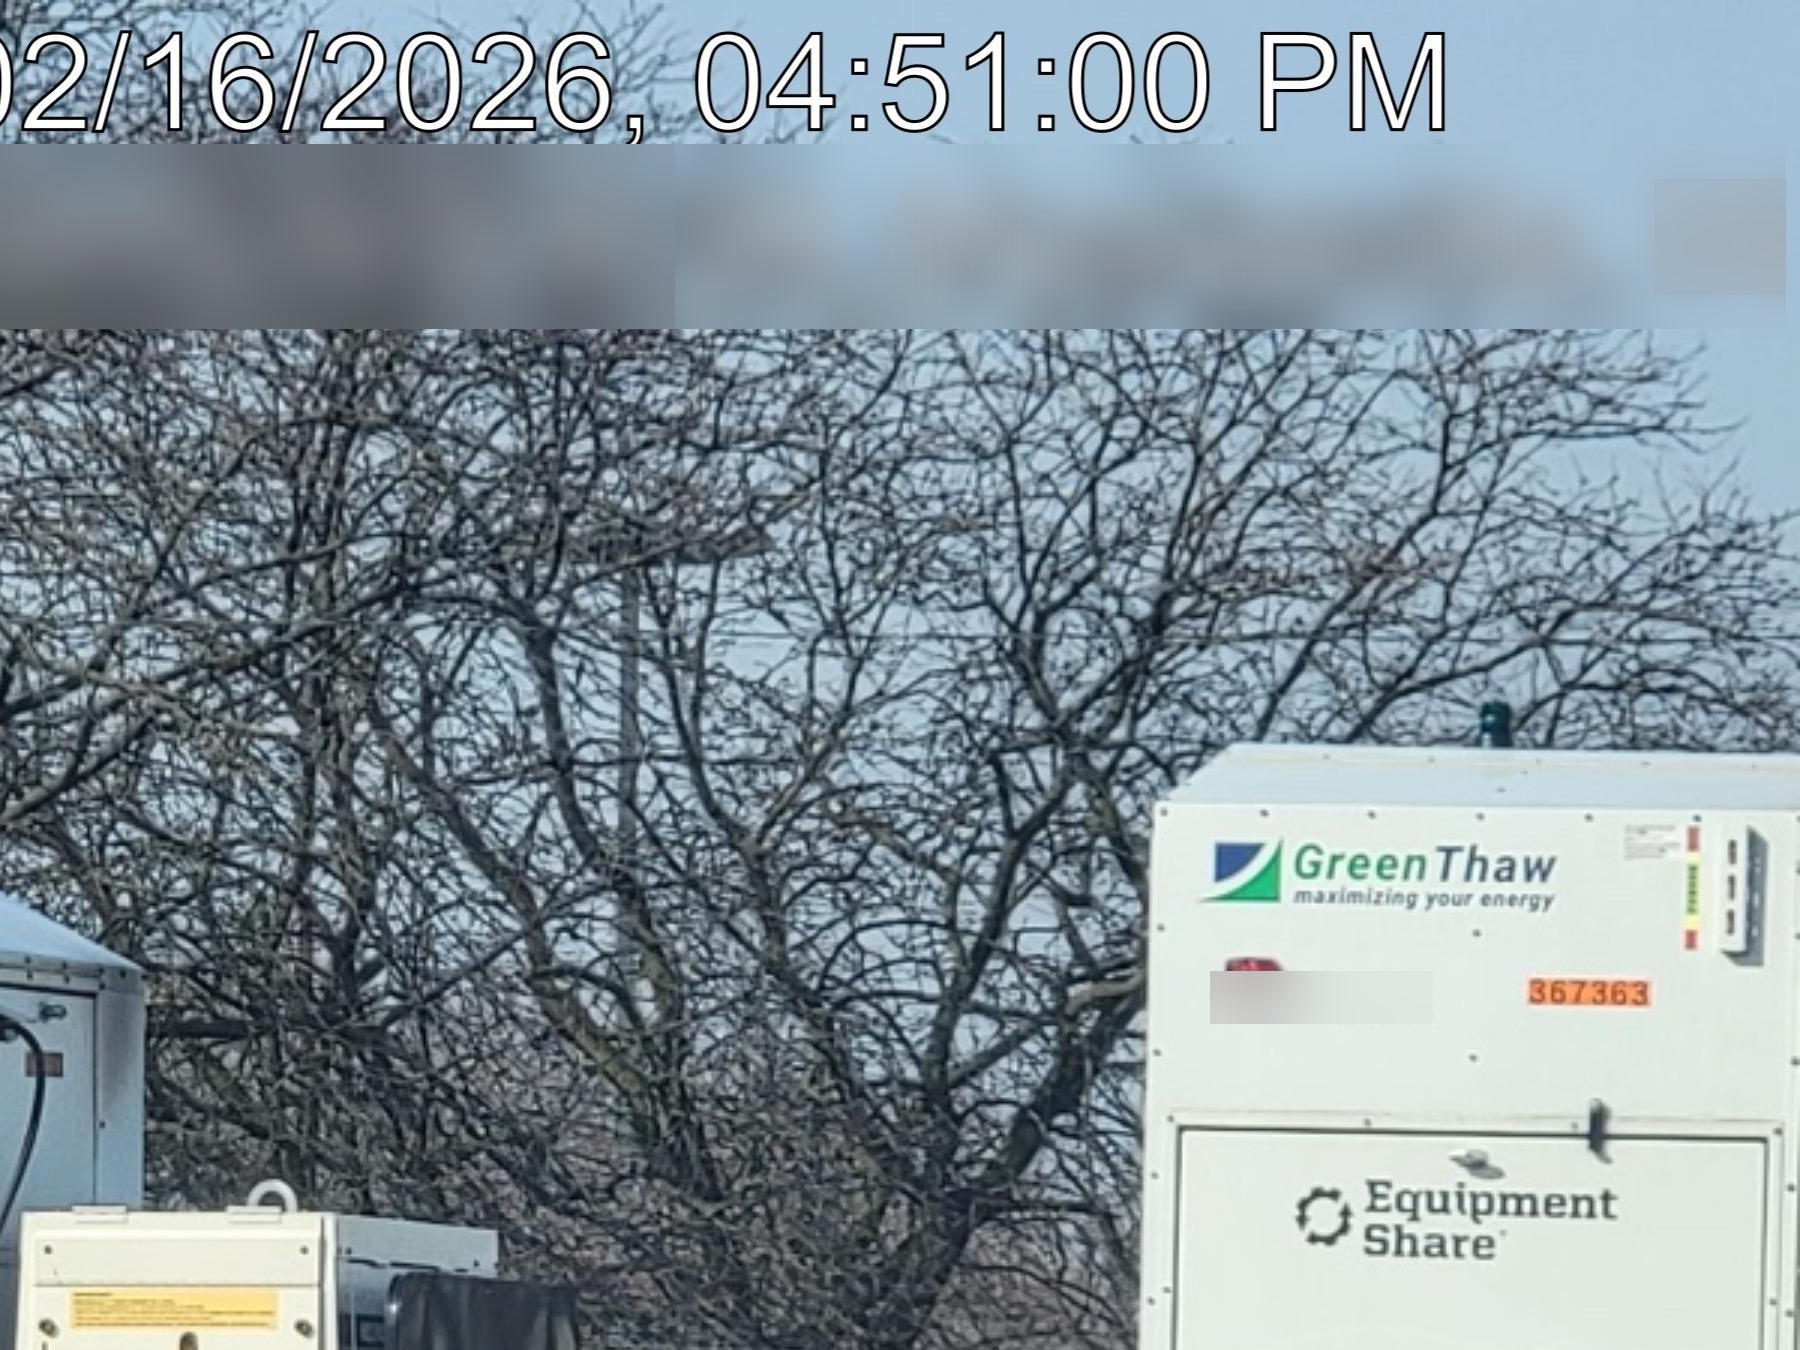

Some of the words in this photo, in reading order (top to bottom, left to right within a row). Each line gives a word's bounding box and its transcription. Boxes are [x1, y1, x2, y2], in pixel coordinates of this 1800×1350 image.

[1293, 887, 1418, 911] maximizing
[1424, 893, 1473, 912] your
[1481, 893, 1555, 912] energy
[1529, 977, 1650, 1007] 367363
[1365, 1179, 1618, 1224] Equipment
[1364, 1223, 1496, 1261] Share
